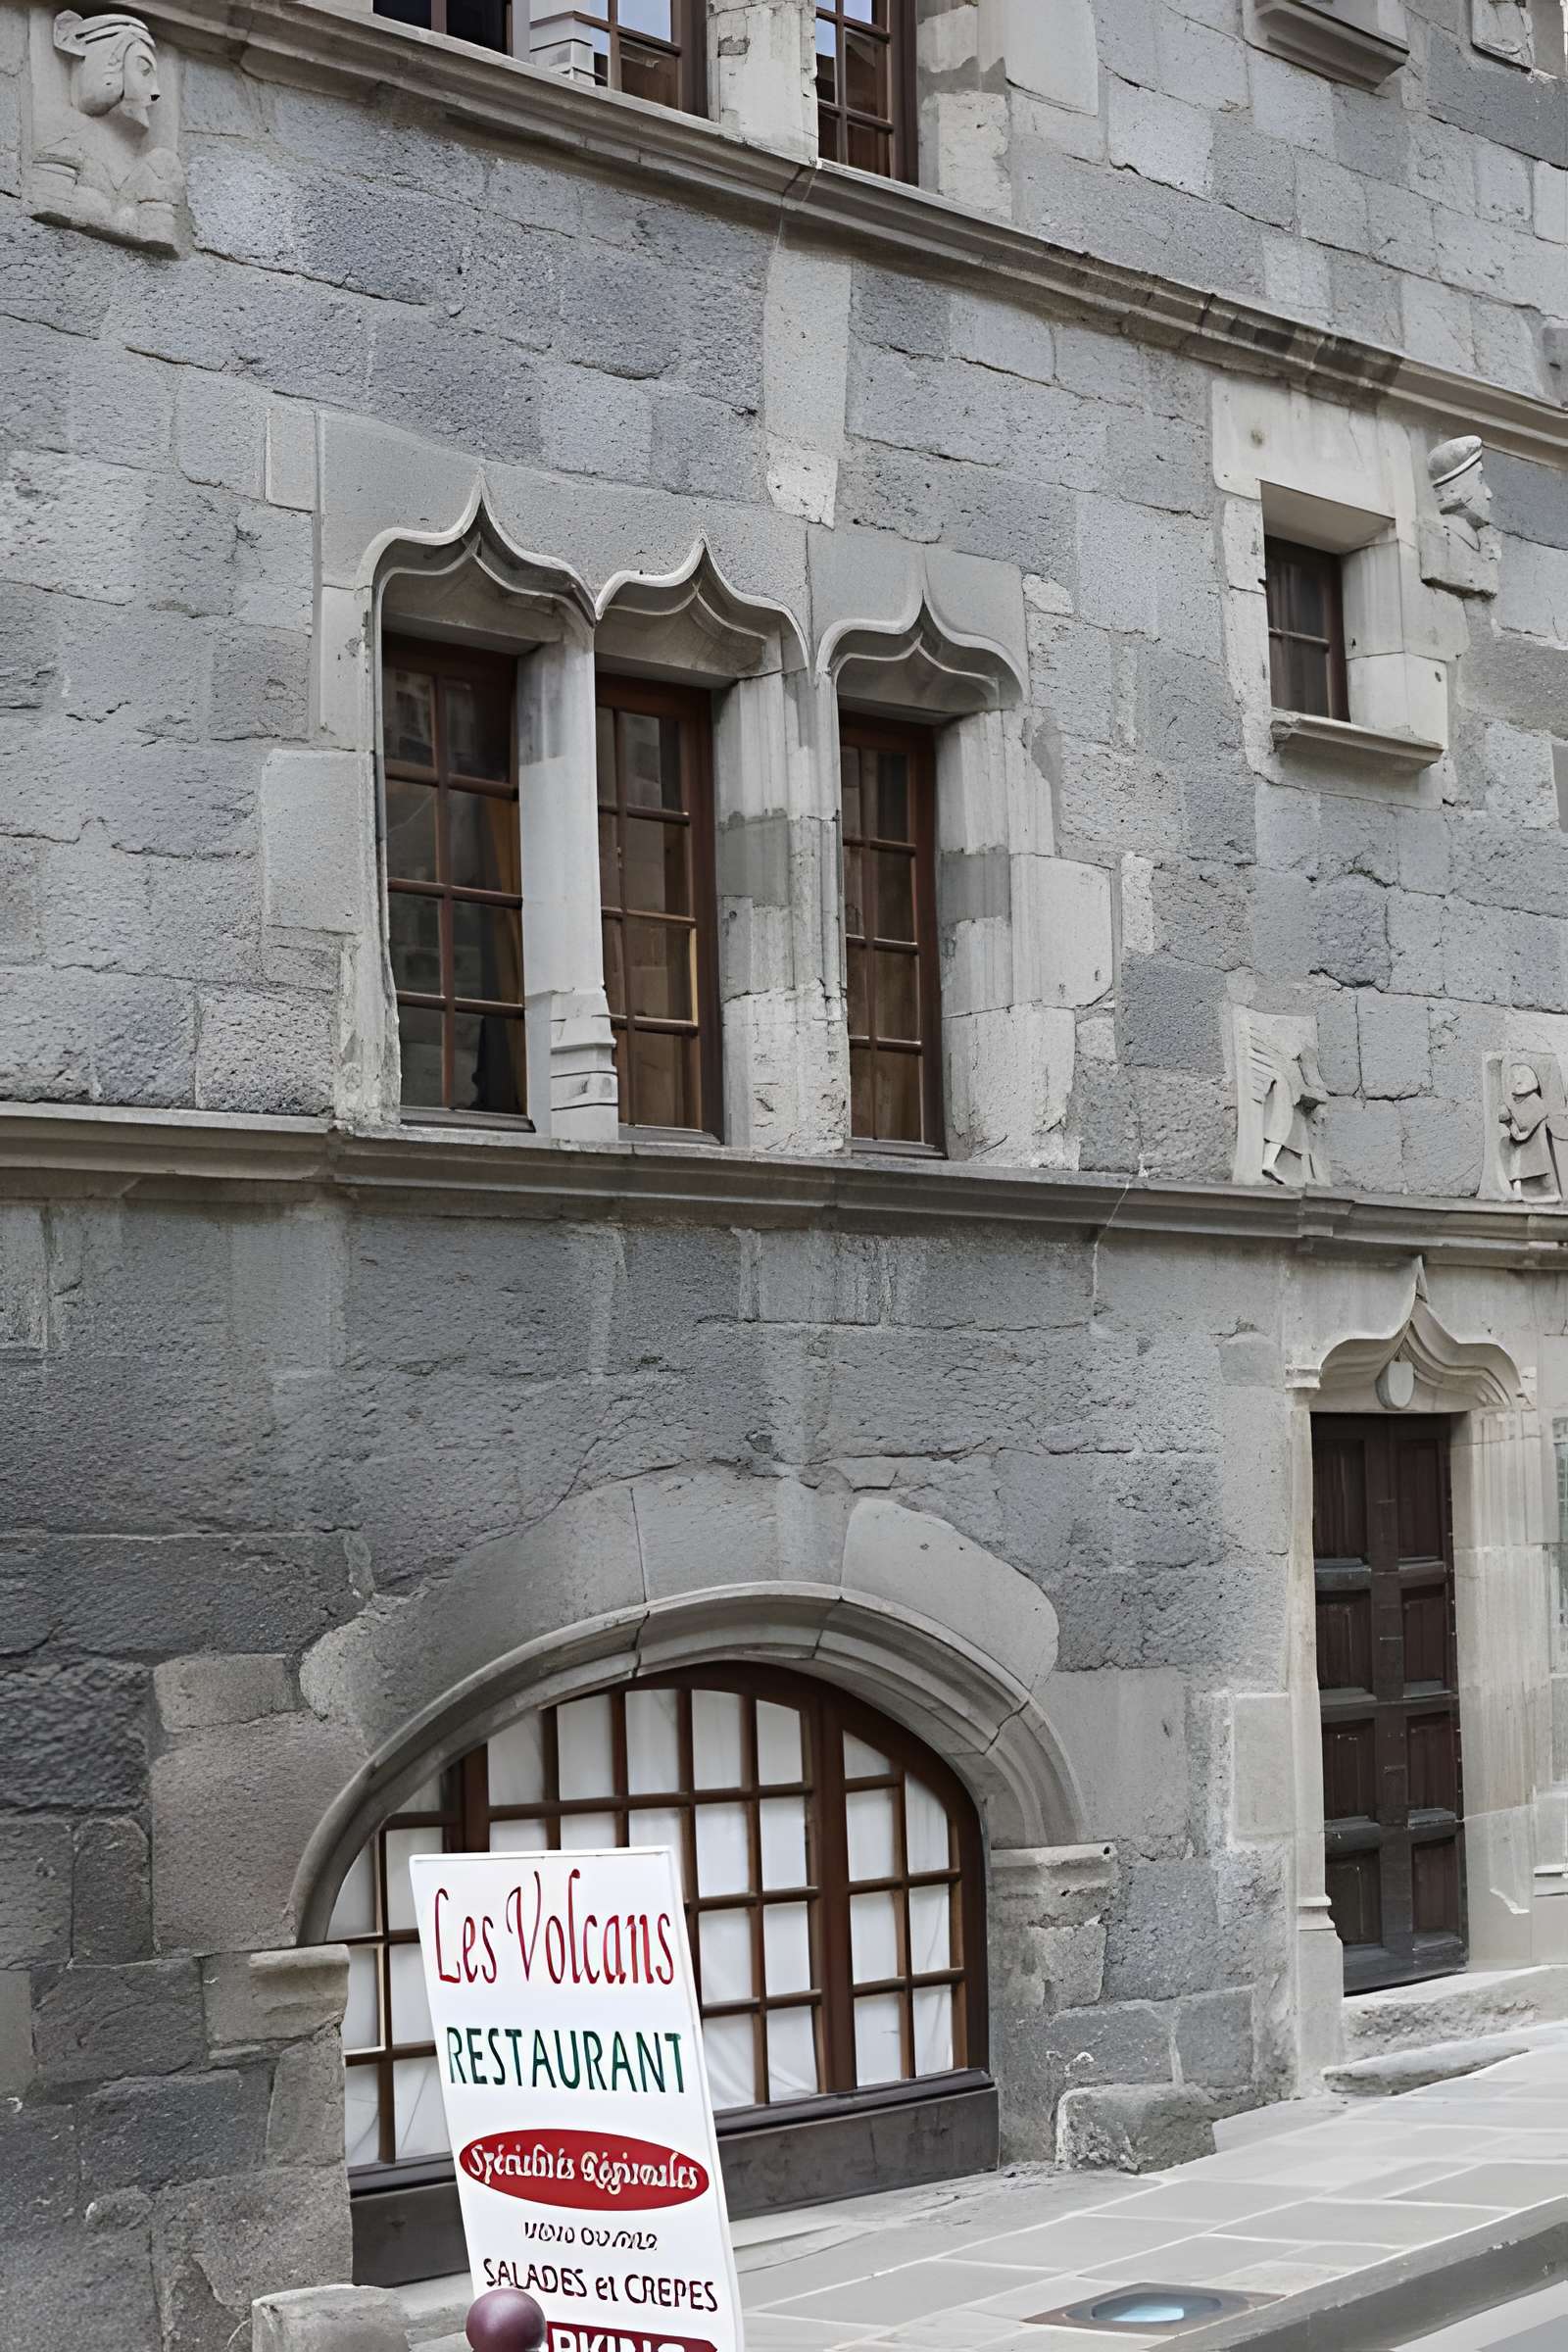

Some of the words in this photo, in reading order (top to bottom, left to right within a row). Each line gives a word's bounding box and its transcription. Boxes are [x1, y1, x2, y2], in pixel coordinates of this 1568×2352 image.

[435, 1887, 497, 1984] Les
[506, 1868, 674, 1985] Volcans
[447, 2027, 684, 2093] RESTAURANT
[483, 2258, 587, 2297] SALADES
[624, 2274, 718, 2312] CREPES
